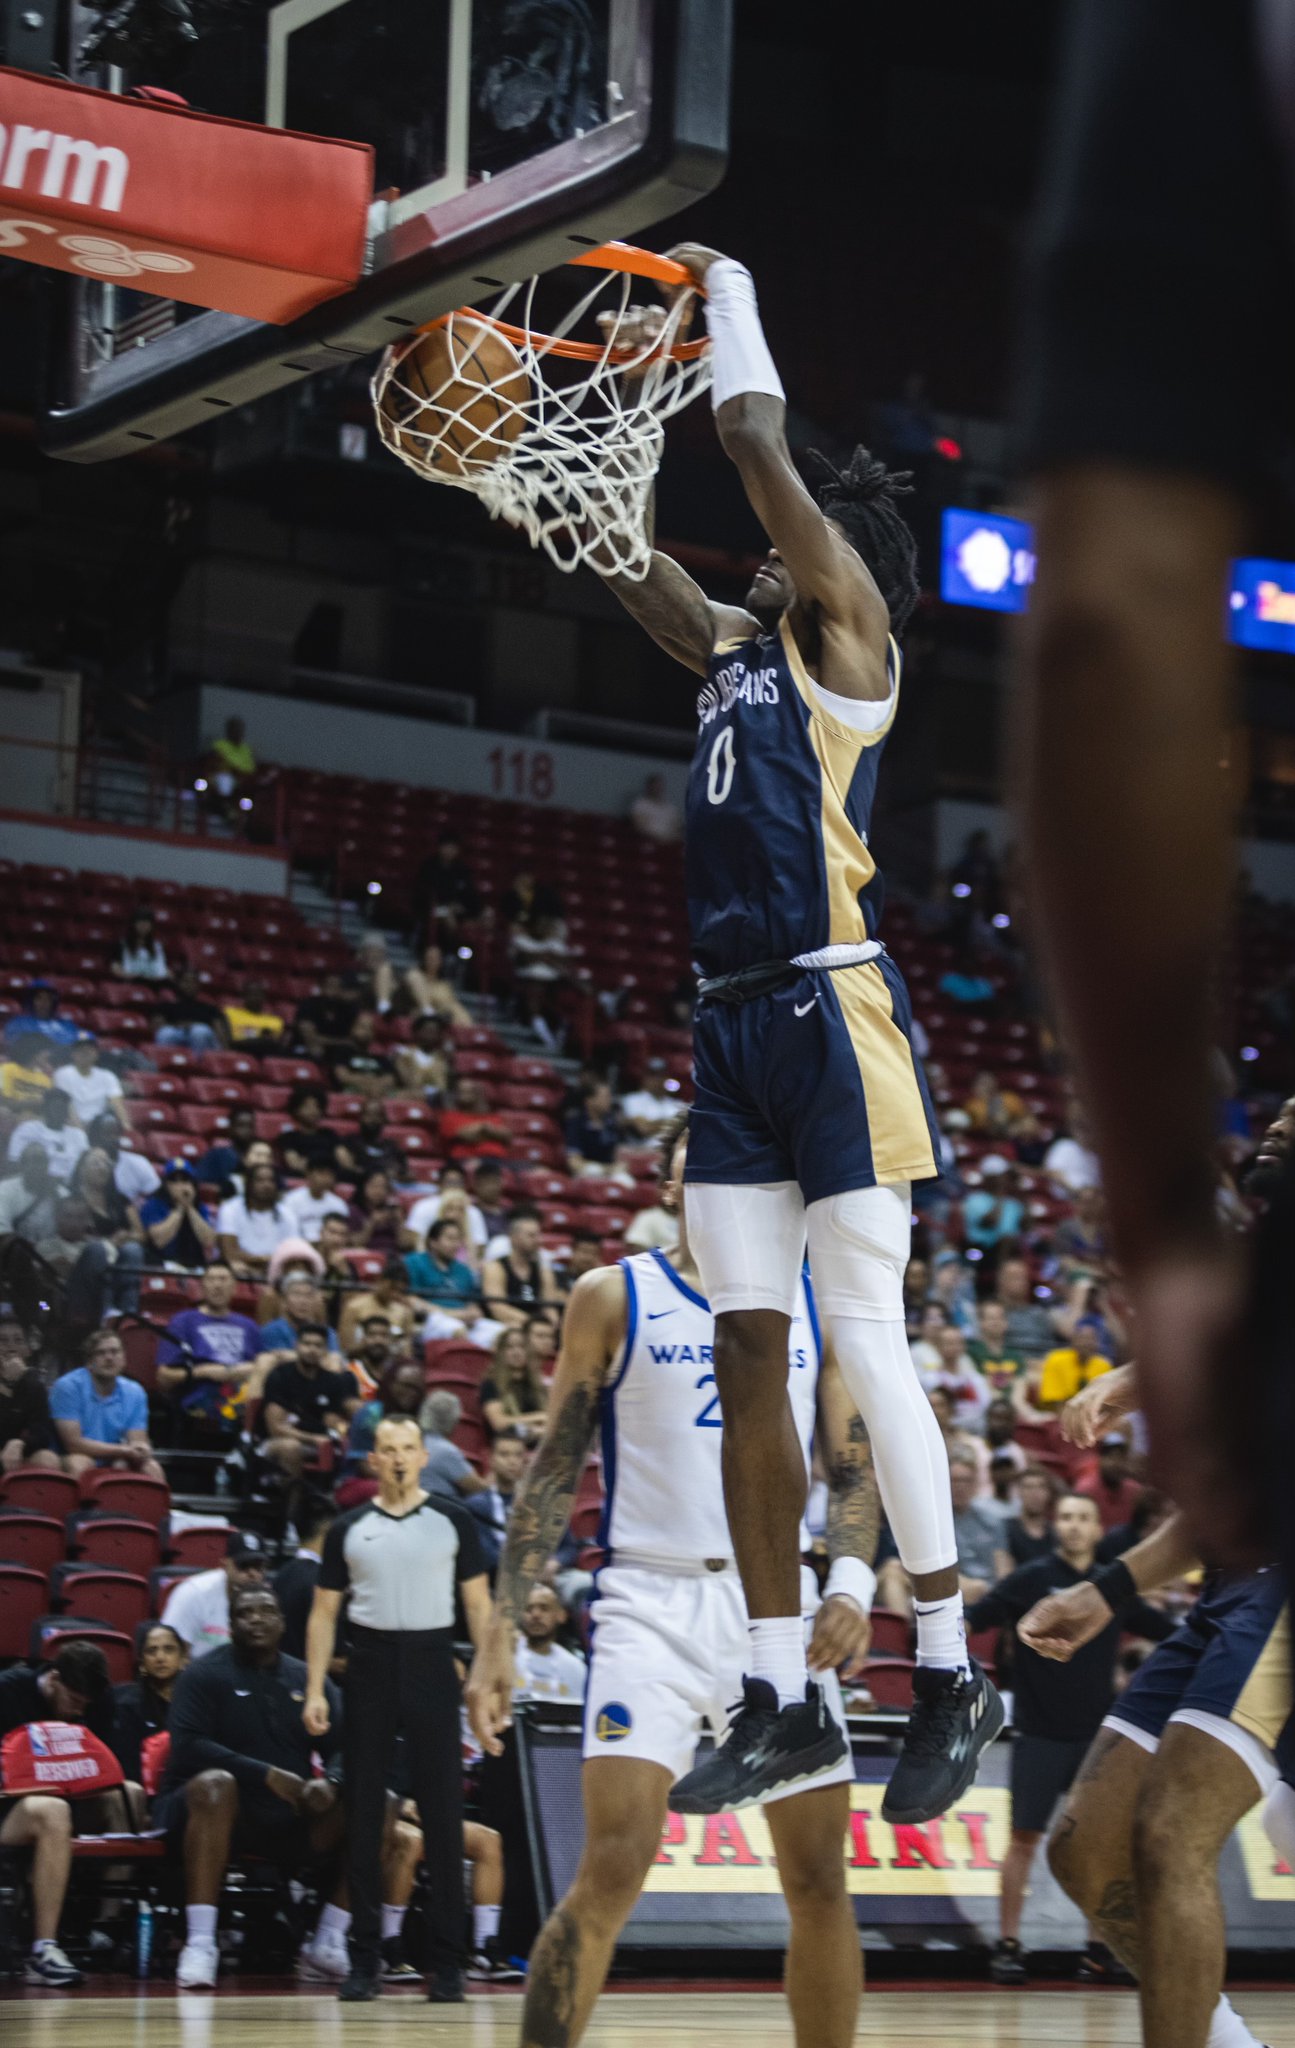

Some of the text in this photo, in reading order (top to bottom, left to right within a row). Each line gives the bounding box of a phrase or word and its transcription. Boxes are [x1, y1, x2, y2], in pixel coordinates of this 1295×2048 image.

[0, 122, 130, 213] rm
[487, 747, 555, 800] 118
[707, 725, 736, 805] 0
[647, 1344, 808, 1369] WARS
[655, 1809, 1003, 1869] PAINI
